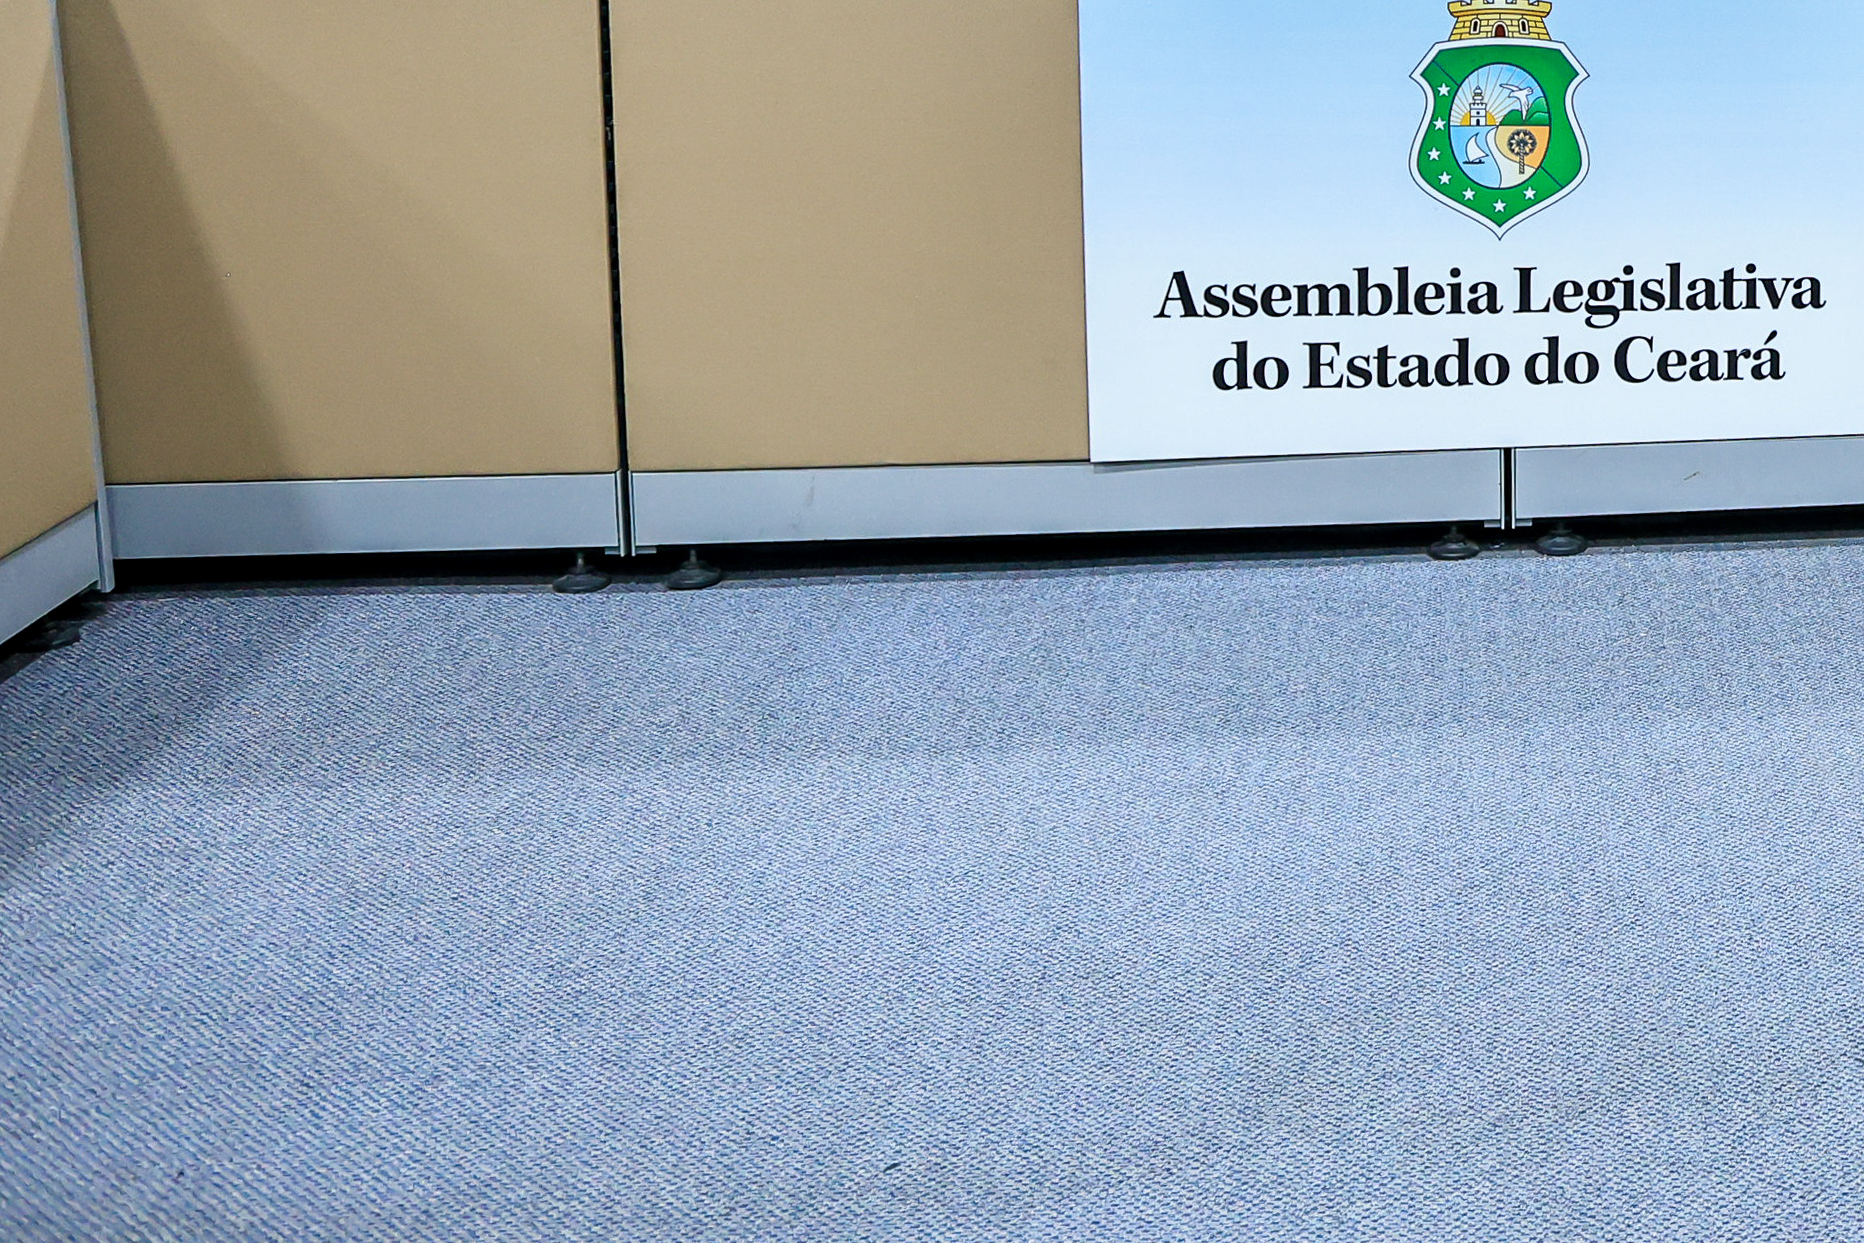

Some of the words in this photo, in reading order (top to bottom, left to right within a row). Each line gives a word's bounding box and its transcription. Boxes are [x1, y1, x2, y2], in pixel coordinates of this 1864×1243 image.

[1154, 266, 1504, 319] Assembleia
[1512, 263, 1827, 329] Legislativa
[1212, 340, 1290, 391] do
[1302, 335, 1511, 389] Estado
[1524, 335, 1600, 386] do
[1613, 329, 1786, 384] Ceará
